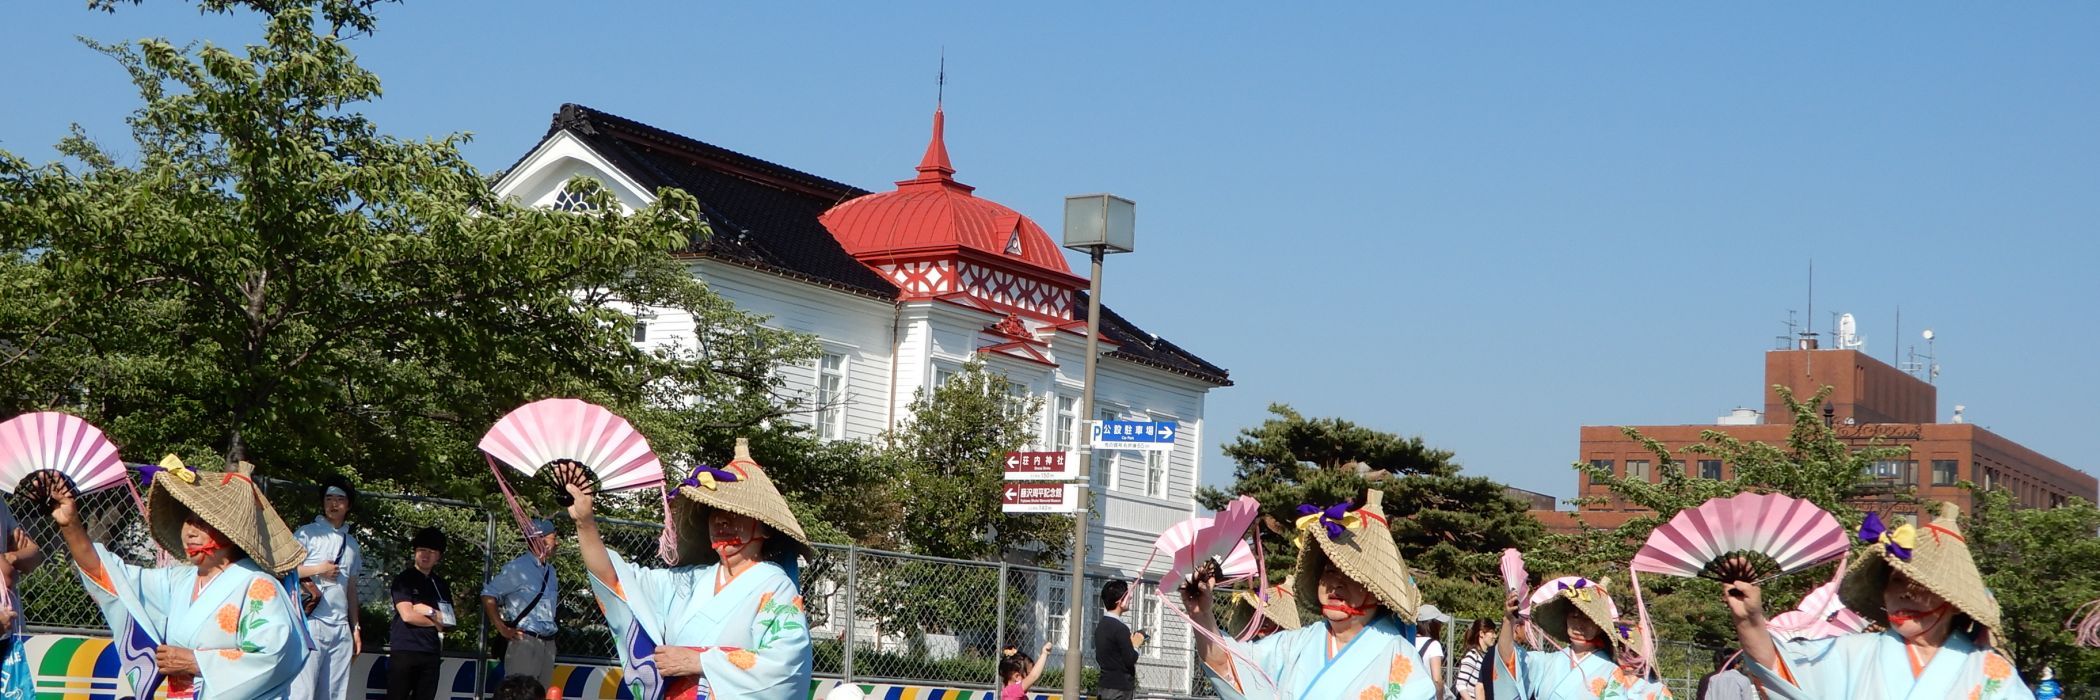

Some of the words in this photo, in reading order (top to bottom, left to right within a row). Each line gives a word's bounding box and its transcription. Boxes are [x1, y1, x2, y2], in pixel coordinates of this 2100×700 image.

[1103, 424, 1154, 436] 公設駐車場
[1022, 455, 1064, 466] 荘内神社
